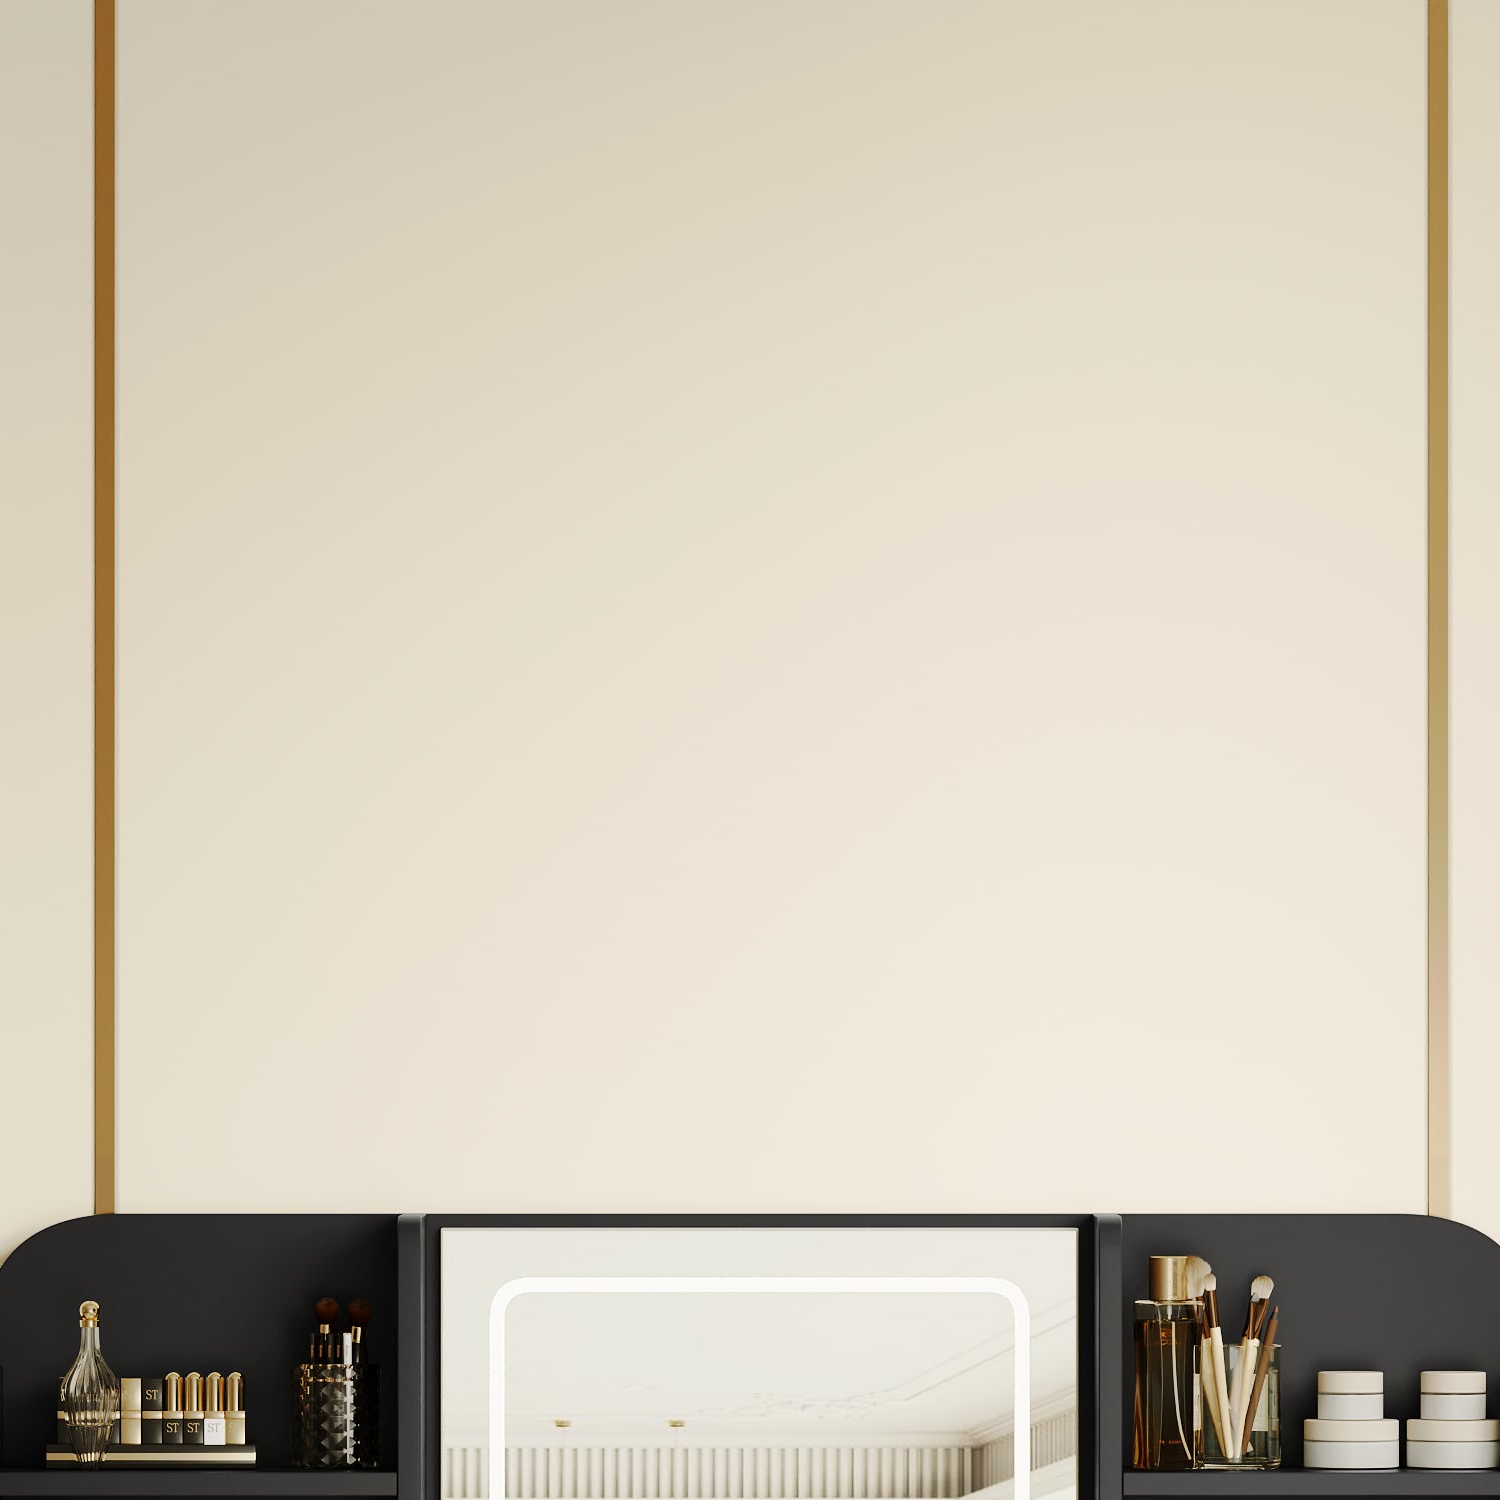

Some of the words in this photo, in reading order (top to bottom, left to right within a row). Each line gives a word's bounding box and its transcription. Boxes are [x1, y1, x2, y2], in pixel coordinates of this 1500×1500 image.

[145, 1389, 159, 1400] ST
[166, 1422, 180, 1433] ST
[186, 1422, 200, 1433] ST
[207, 1422, 220, 1433] ST
